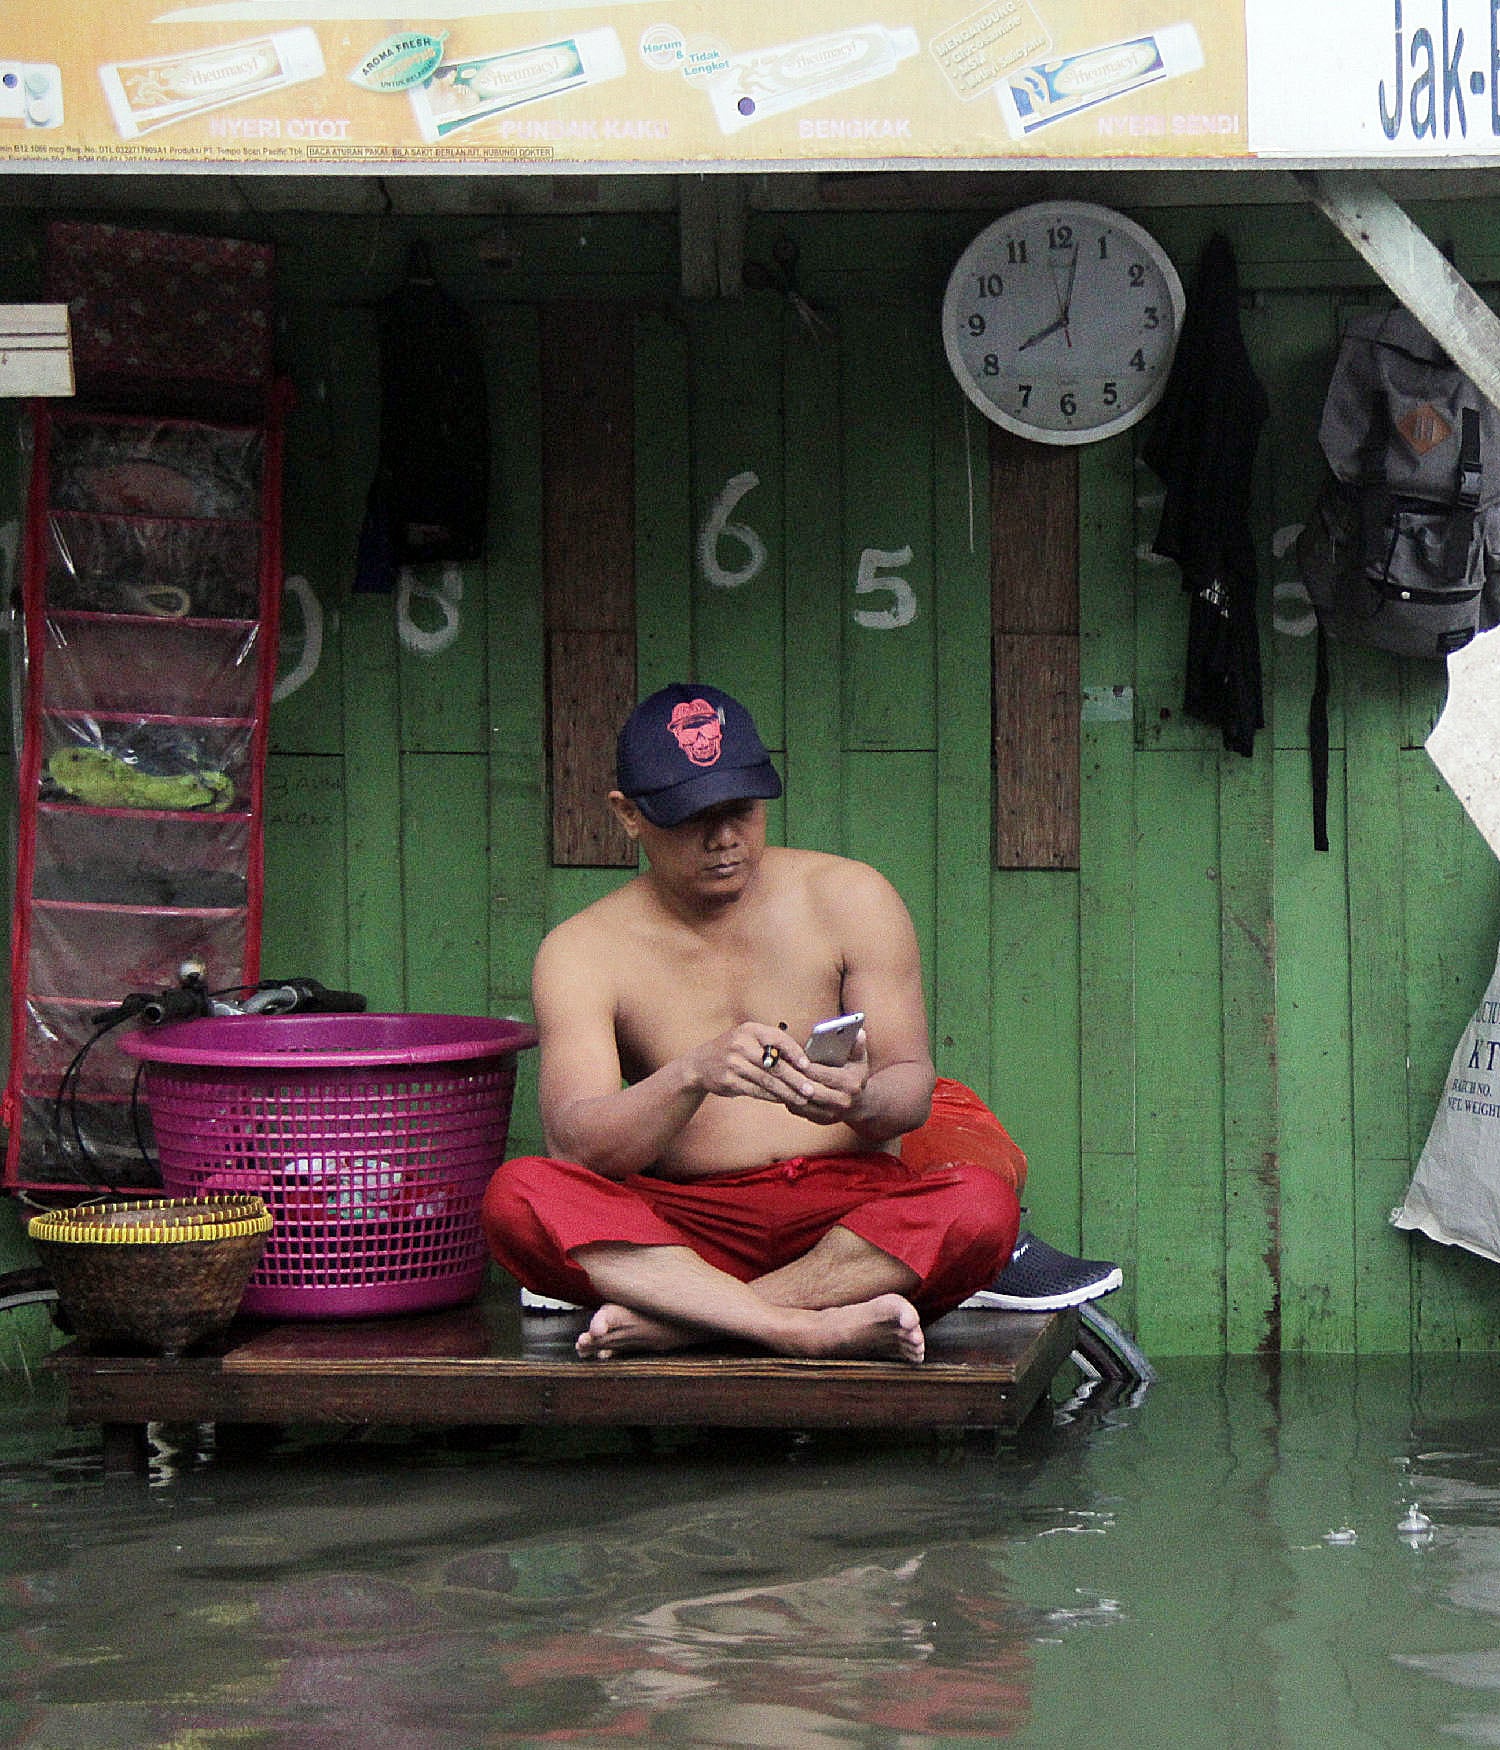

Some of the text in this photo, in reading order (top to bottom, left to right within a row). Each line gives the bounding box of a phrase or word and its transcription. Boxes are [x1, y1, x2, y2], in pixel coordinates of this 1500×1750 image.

[361, 47, 394, 77] AROMA
[396, 37, 431, 52] FRESH
[642, 40, 682, 54] Harum
[675, 50, 684, 59] &
[689, 50, 720, 63] Tidak
[684, 60, 730, 76] Lengket
[208, 119, 350, 138] NYERI OTOT
[501, 120, 599, 139] PUNDAK
[799, 119, 912, 139] BENGKAK
[332, 148, 364, 156] ATURAN
[484, 148, 517, 157] HUBUNGI
[520, 148, 551, 157] DOKTER
[1046, 225, 1074, 249] 12
[1097, 236, 1107, 259] 1
[1006, 239, 1028, 264] 11
[976, 273, 1004, 299] 10
[1128, 264, 1145, 288] 2
[968, 313, 985, 336] 9
[1143, 306, 1160, 329] 3
[984, 353, 999, 376] 8
[1130, 349, 1147, 372] 4
[1018, 384, 1032, 408] 7
[1060, 393, 1077, 416] 6
[1103, 382, 1117, 405] 5
[702, 470, 768, 588] 6
[854, 544, 917, 630] 5
